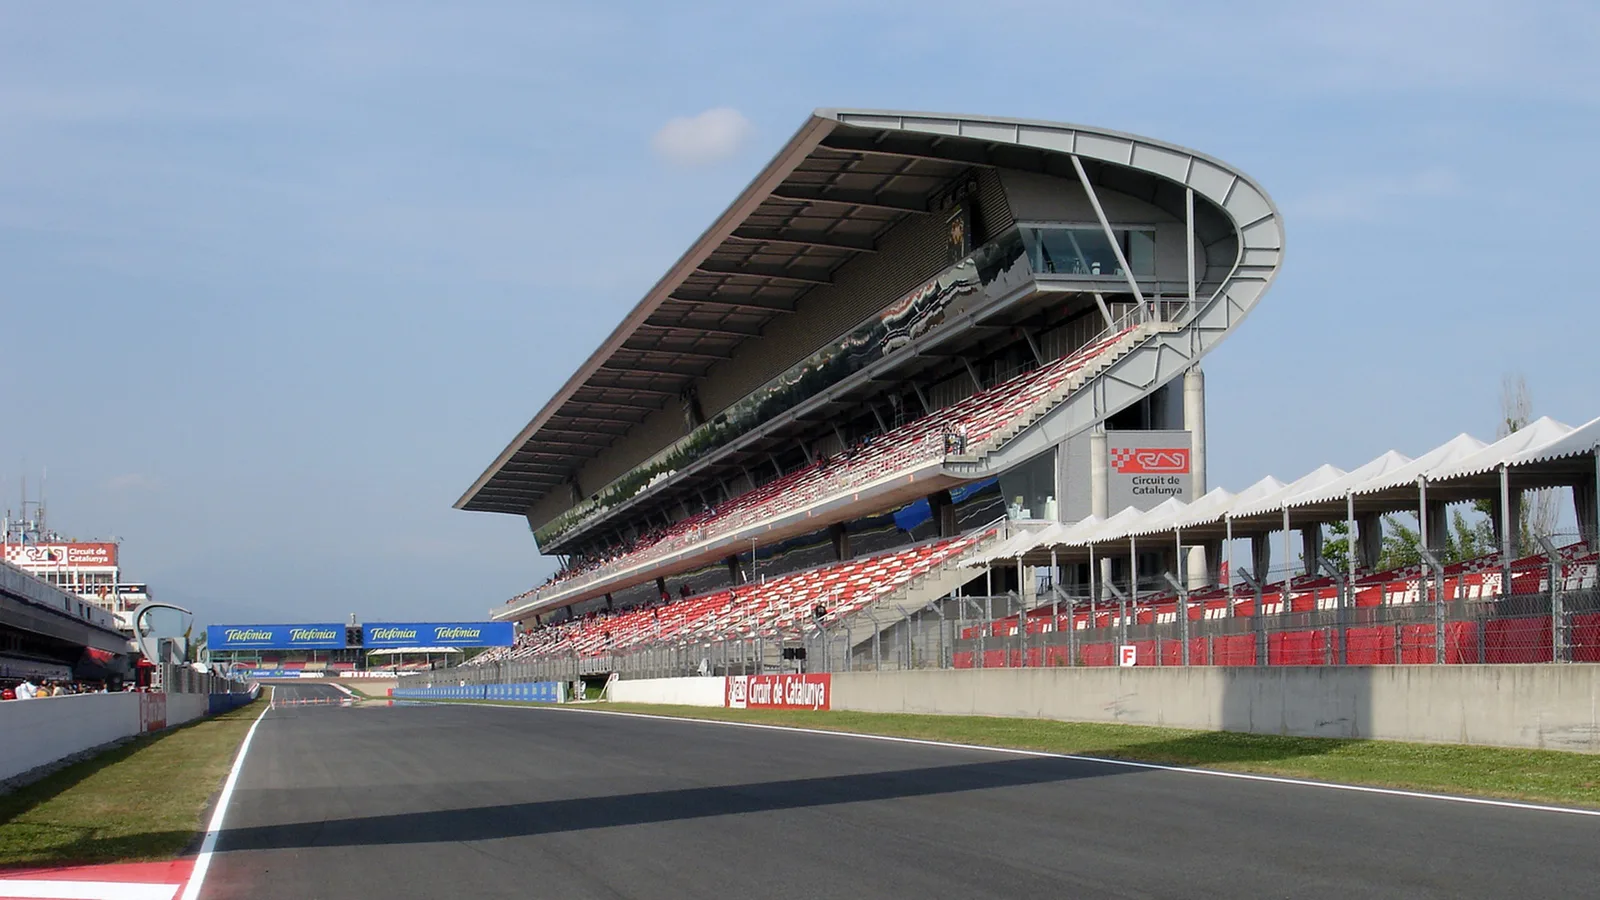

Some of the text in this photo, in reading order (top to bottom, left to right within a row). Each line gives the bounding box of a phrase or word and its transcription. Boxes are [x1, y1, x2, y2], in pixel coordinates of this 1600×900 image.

[1132, 476, 1180, 485] Circuit de
[1132, 485, 1182, 496] Catalunya
[69, 555, 108, 563] Catalunya
[1123, 649, 1133, 663] F
[749, 674, 824, 711] Circuit de Catalunya
